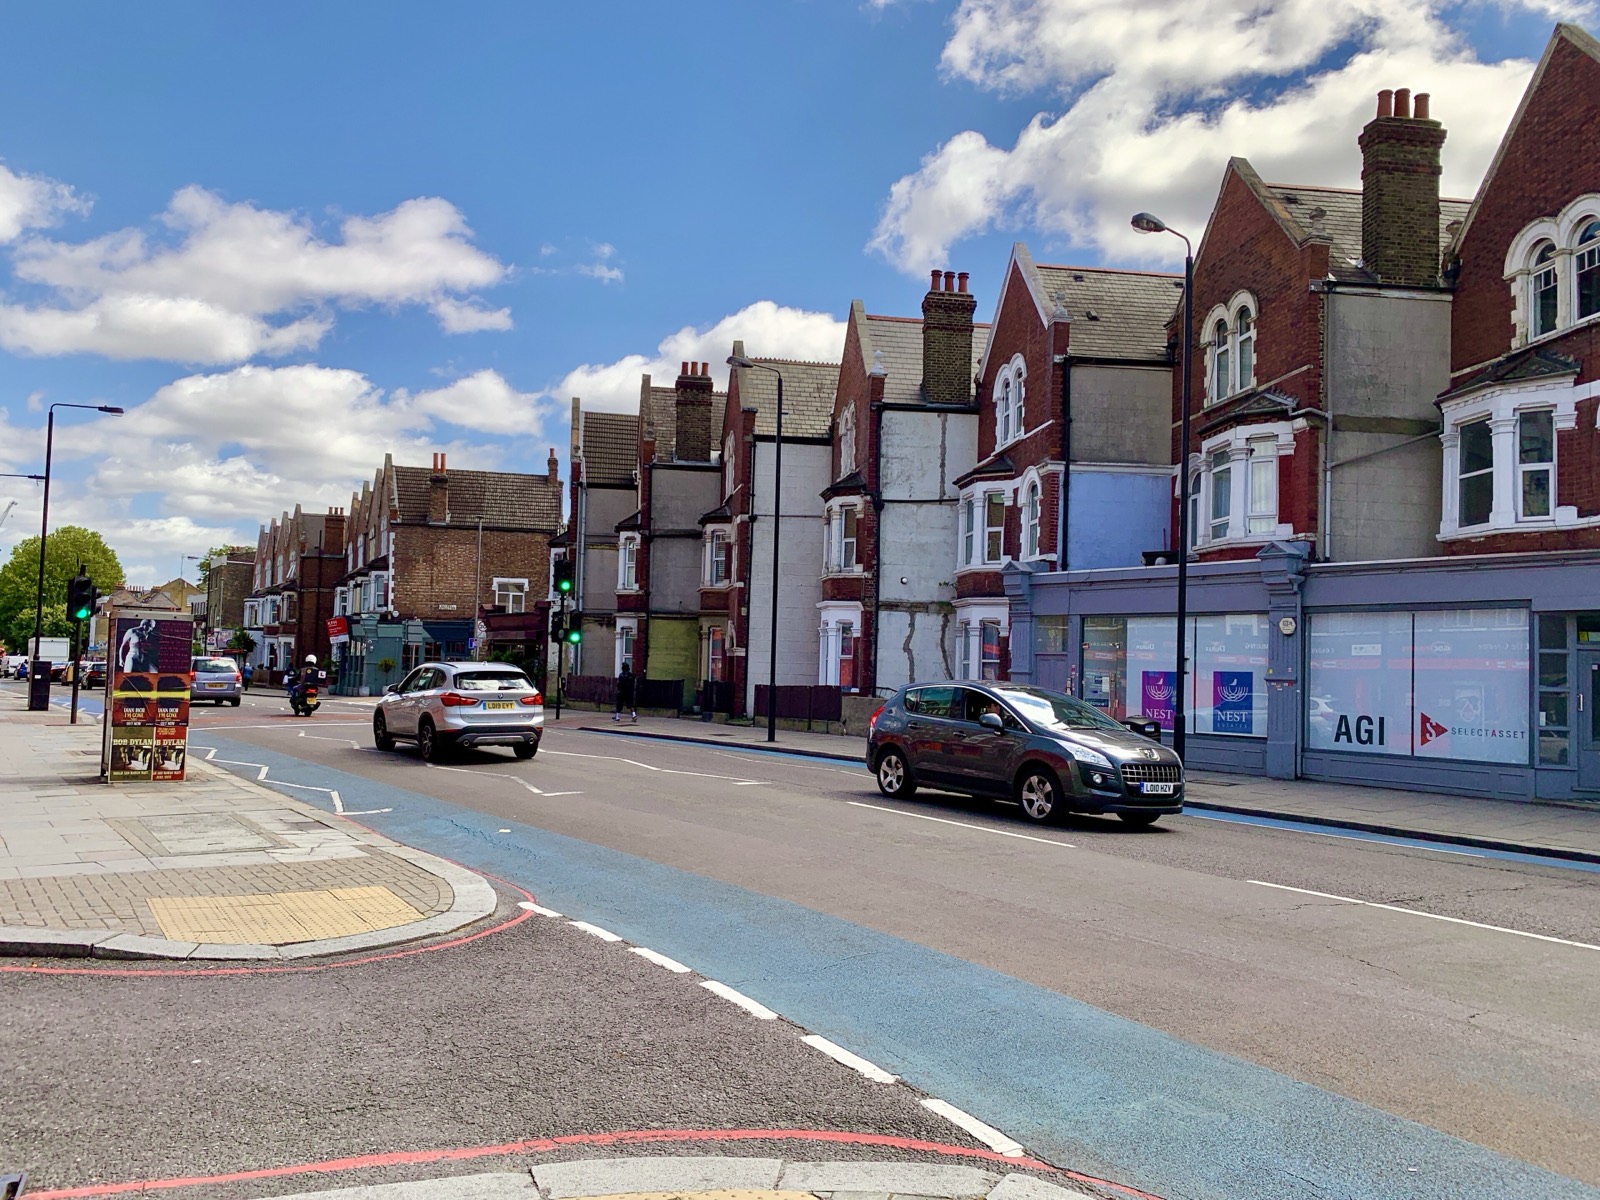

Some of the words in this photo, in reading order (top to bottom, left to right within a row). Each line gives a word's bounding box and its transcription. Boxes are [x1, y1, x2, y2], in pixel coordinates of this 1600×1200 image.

[1145, 708, 1174, 720] NEST
[1217, 711, 1249, 723] NEST
[1334, 714, 1385, 746] AGI
[1451, 726, 1526, 739] SELECTASSET
[113, 738, 128, 746] BOB
[129, 738, 153, 746] DYLAN
